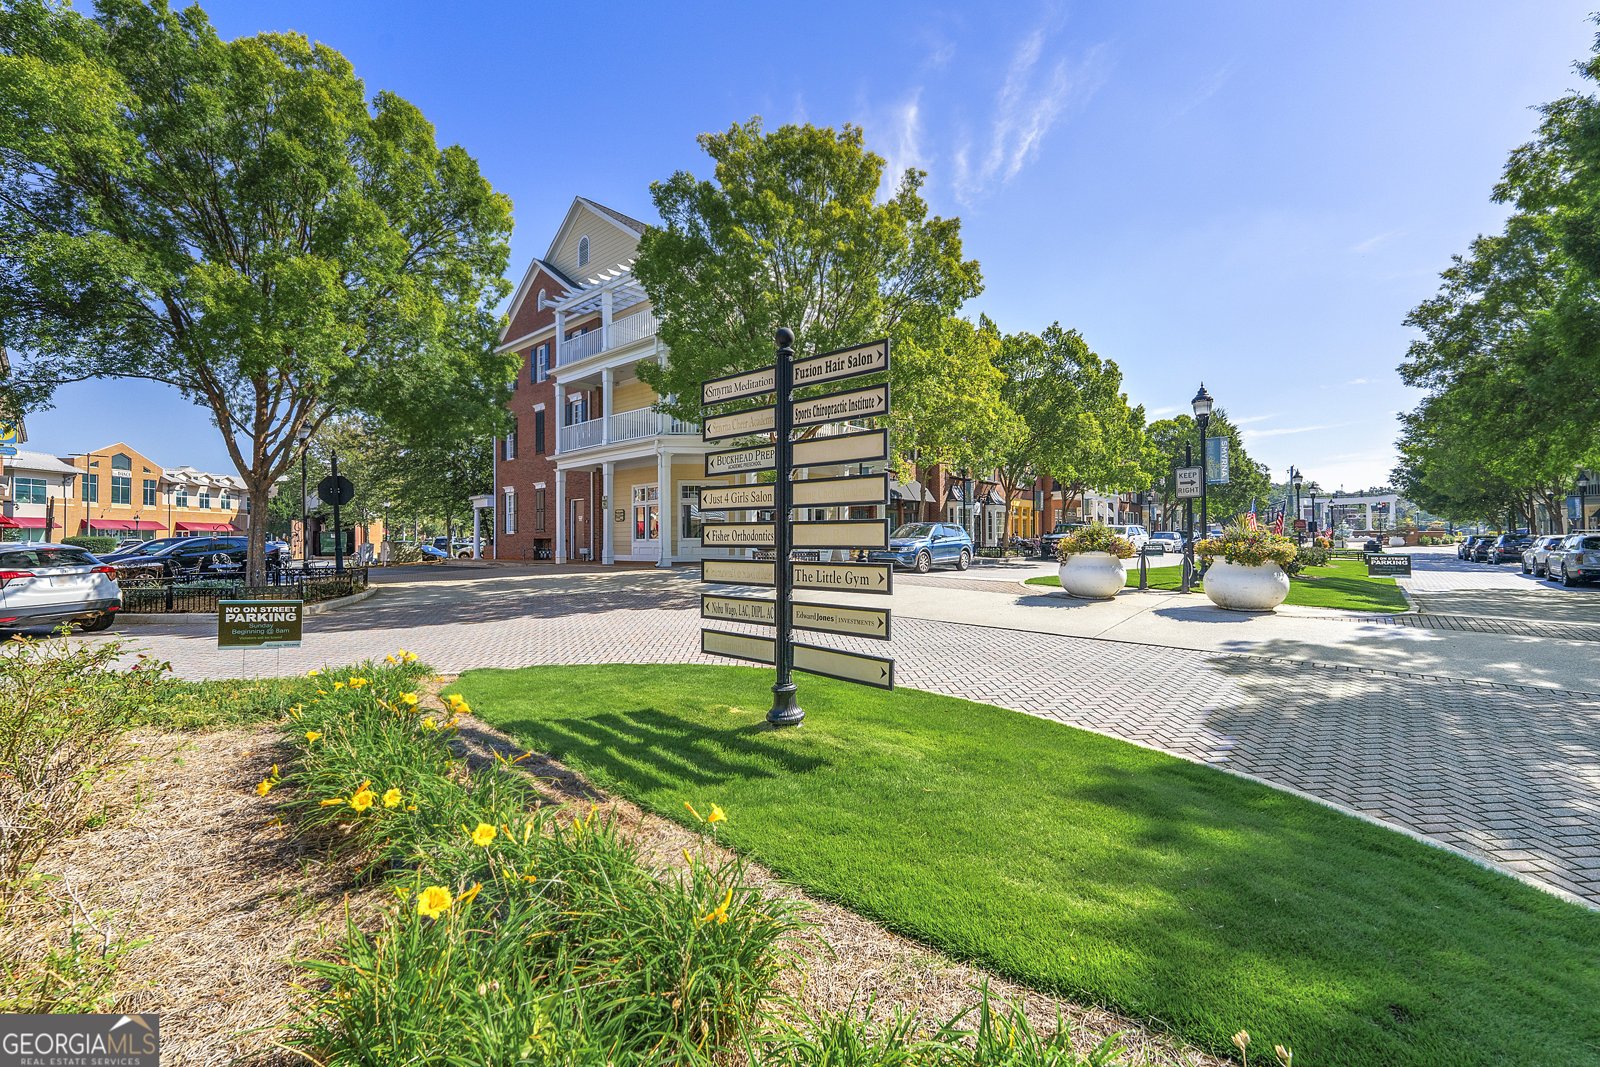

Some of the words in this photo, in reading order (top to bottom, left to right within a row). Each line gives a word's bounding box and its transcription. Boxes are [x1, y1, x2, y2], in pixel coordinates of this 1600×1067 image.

[794, 365, 823, 380] Fuzion
[825, 358, 845, 374] Hair
[847, 352, 873, 369] Salon
[707, 384, 733, 399] Smyrna
[734, 376, 774, 393] Meditation
[794, 407, 812, 421] Sports
[813, 400, 847, 419] Chiropractic
[848, 396, 875, 412] Institute
[716, 452, 754, 466] BUCKHEAD
[755, 449, 775, 460] PREP
[1220, 440, 1228, 478] SMYRNA
[708, 494, 723, 505] Just
[724, 493, 729, 503] 4
[731, 492, 749, 504] Girls
[750, 490, 773, 503] Salon
[712, 530, 730, 541] Fisher
[731, 529, 774, 542] Orthodontics
[794, 568, 813, 583] The
[816, 569, 842, 585] Little
[844, 570, 870, 588] Gym
[226, 613, 297, 622] PARKING
[711, 602, 723, 614] Nobu
[724, 602, 738, 617] Wago,
[838, 617, 875, 626] INVESTMENTS
